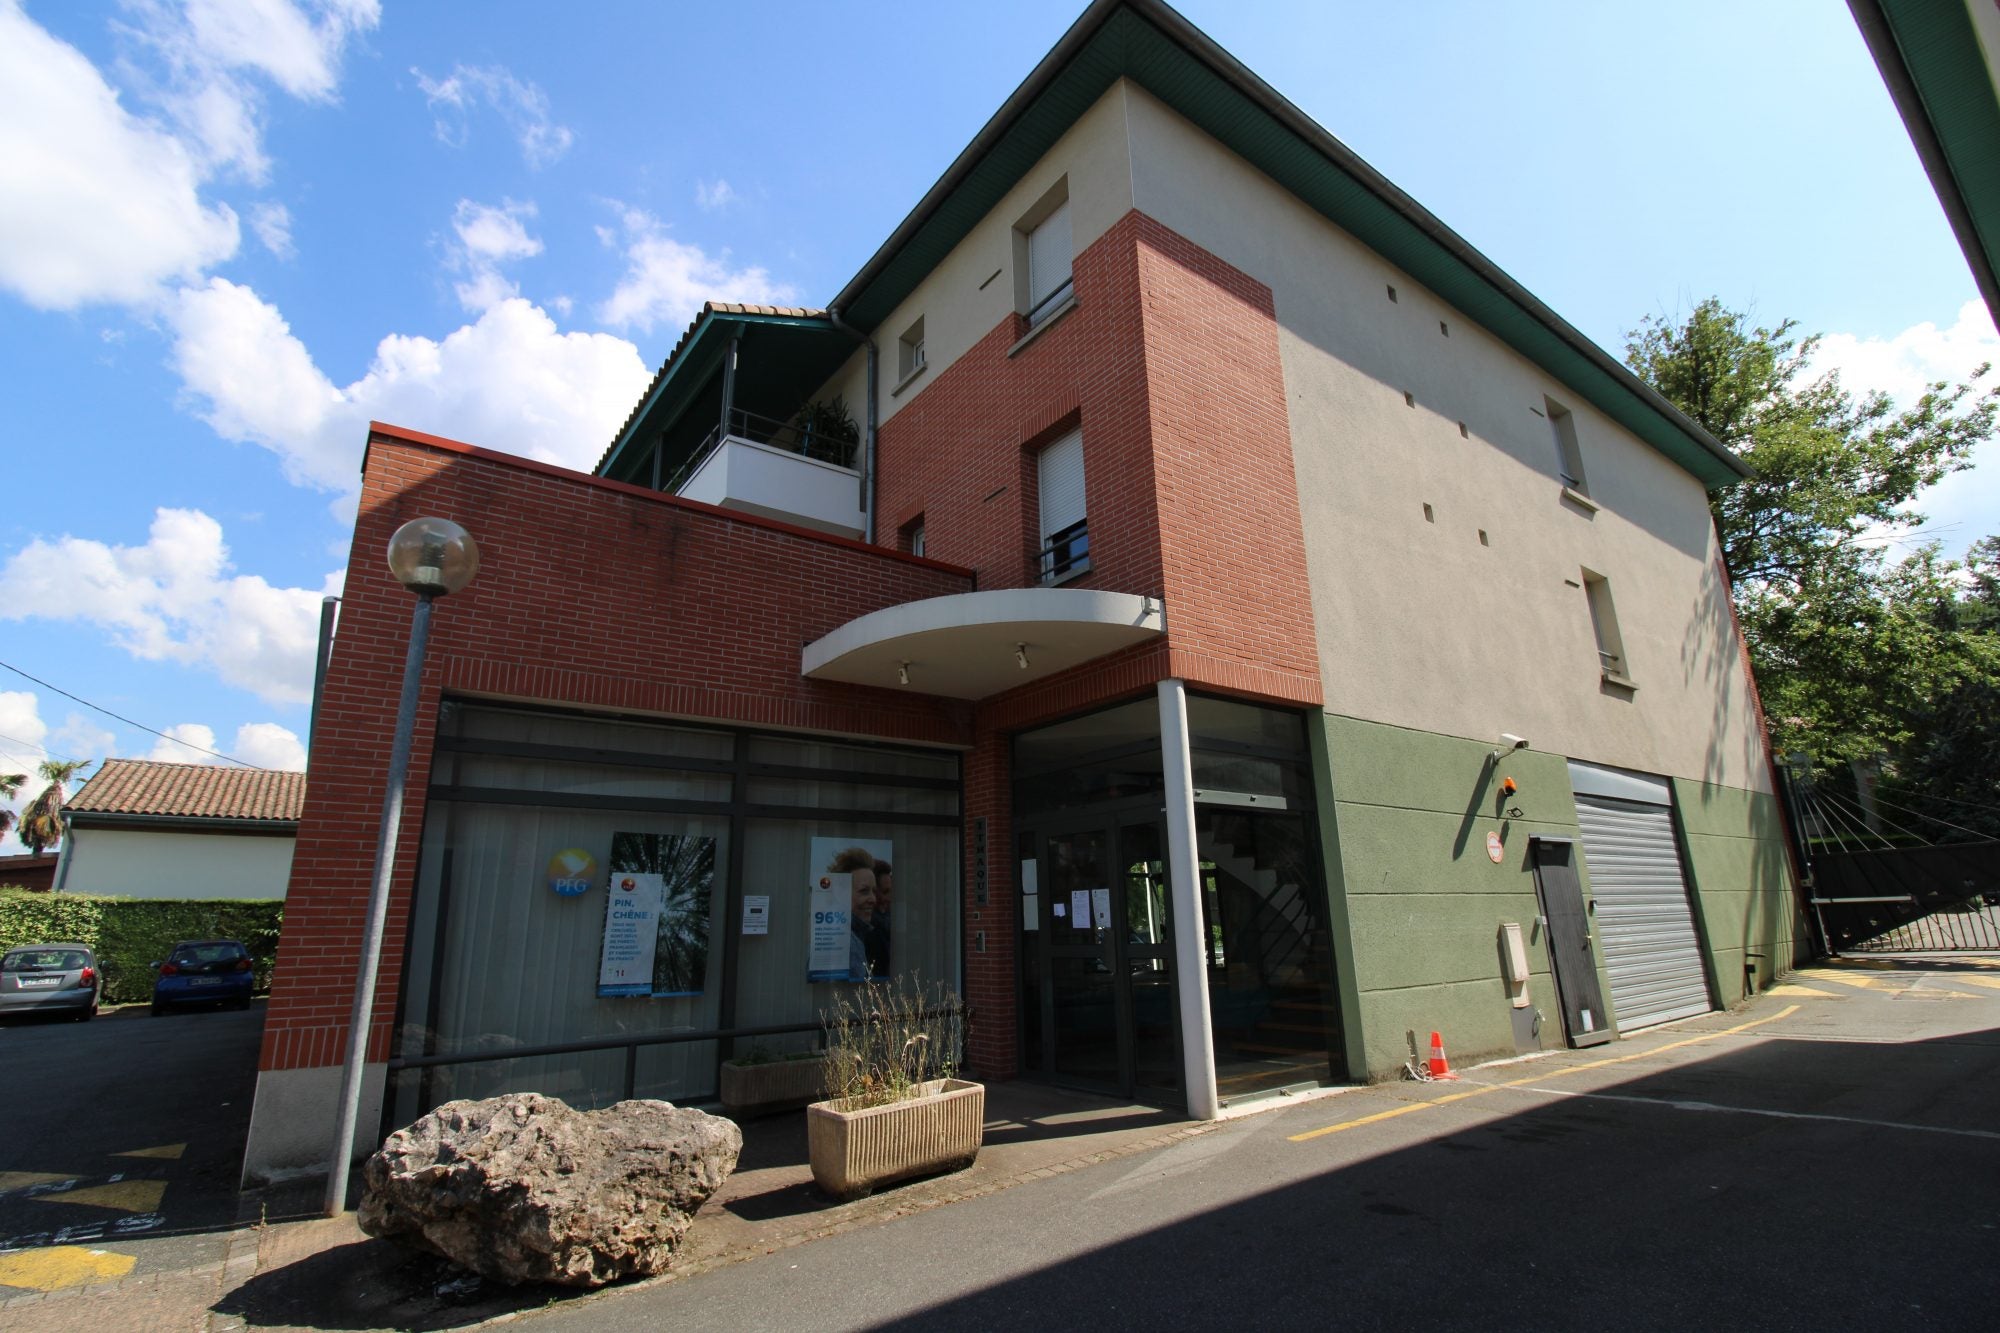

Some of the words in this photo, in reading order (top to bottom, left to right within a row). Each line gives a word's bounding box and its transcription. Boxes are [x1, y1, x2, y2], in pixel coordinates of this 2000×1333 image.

[976, 821, 986, 903] ITHAQUE
[555, 877, 588, 893] PFG
[614, 899, 635, 908] PIN,
[612, 909, 648, 919] CHÊNE
[814, 911, 847, 924] 96%
